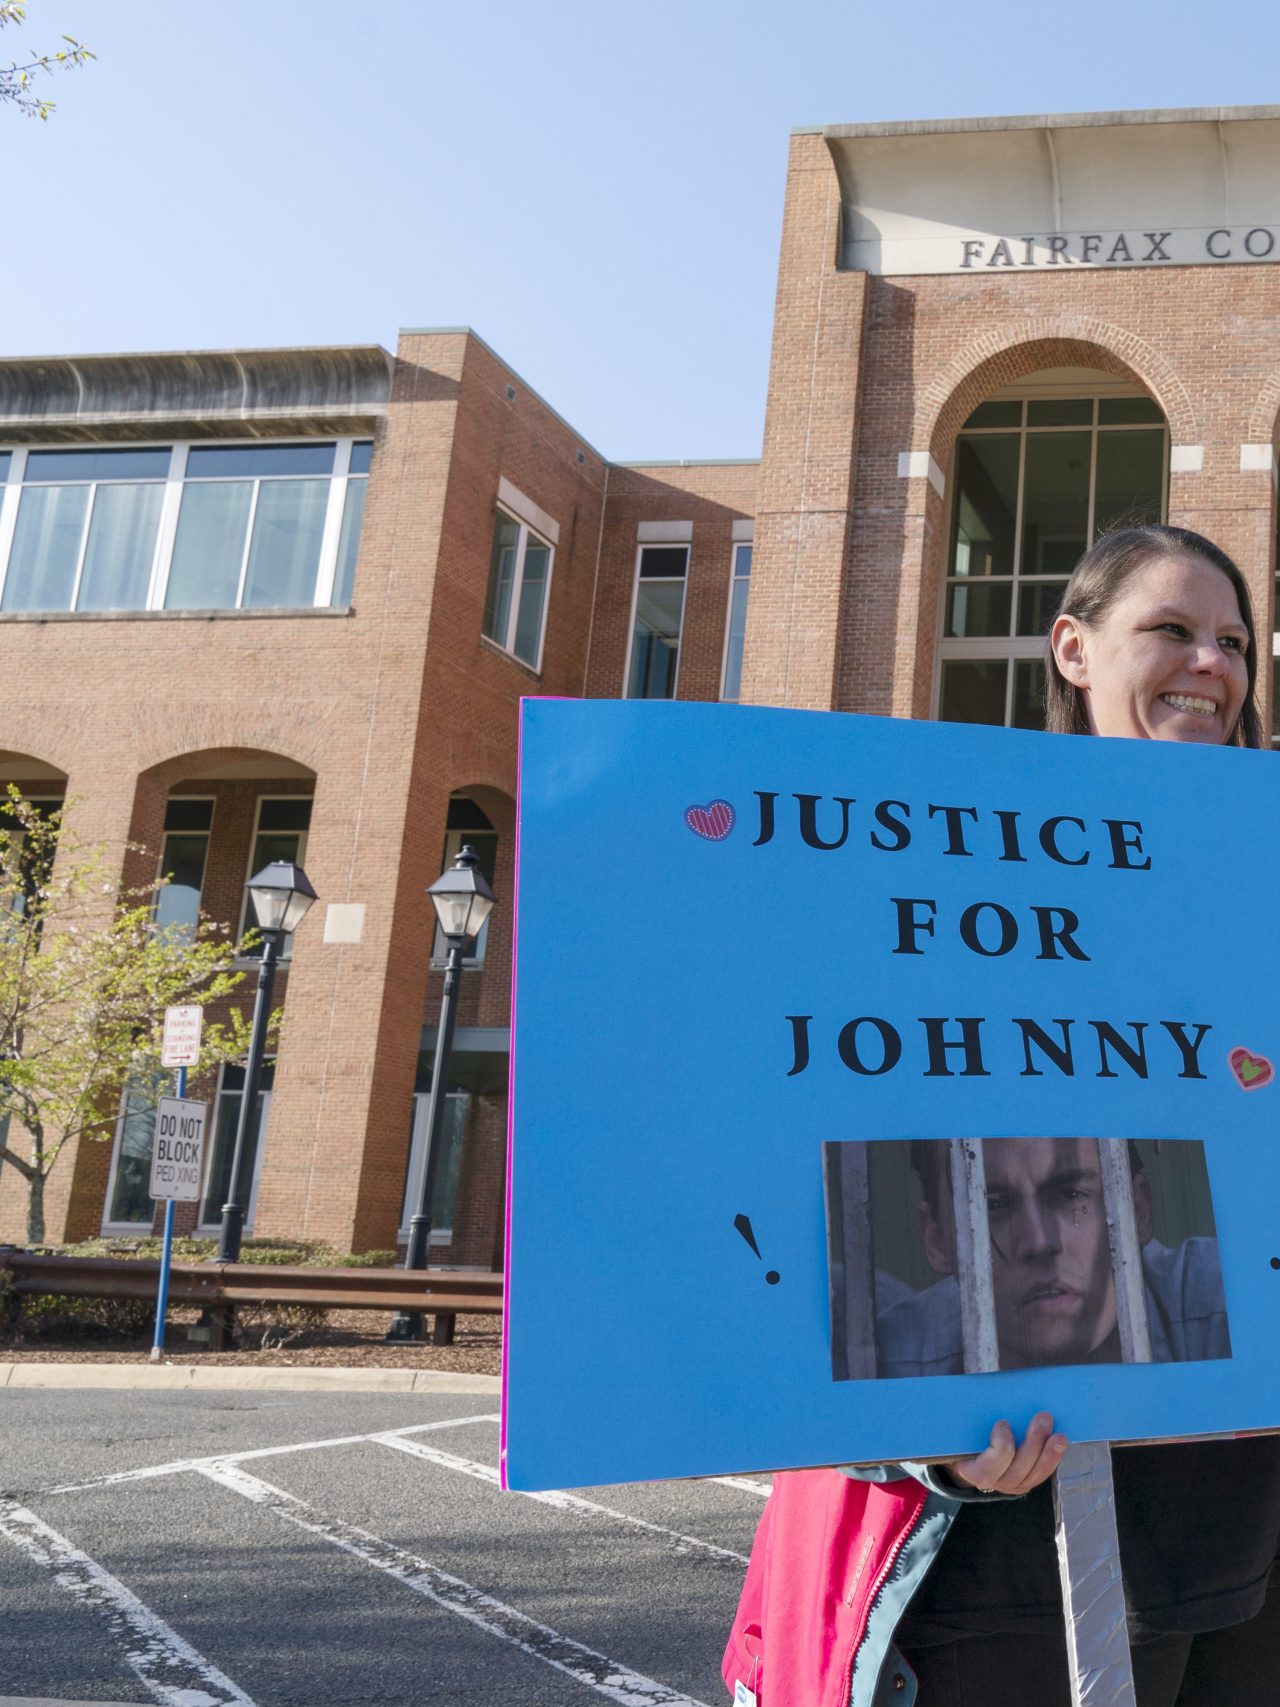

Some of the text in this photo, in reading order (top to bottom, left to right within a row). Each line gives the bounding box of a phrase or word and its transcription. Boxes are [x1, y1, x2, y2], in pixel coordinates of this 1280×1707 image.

[959, 231, 1173, 268] FAIRFAX
[752, 790, 1152, 871] JUSTICE
[890, 897, 1091, 962] FOR
[784, 1015, 1213, 1080] JOHNNY
[160, 1114, 203, 1140] DO NOT
[158, 1139, 200, 1164] BLOCK
[155, 1165, 198, 1185] PED XING
